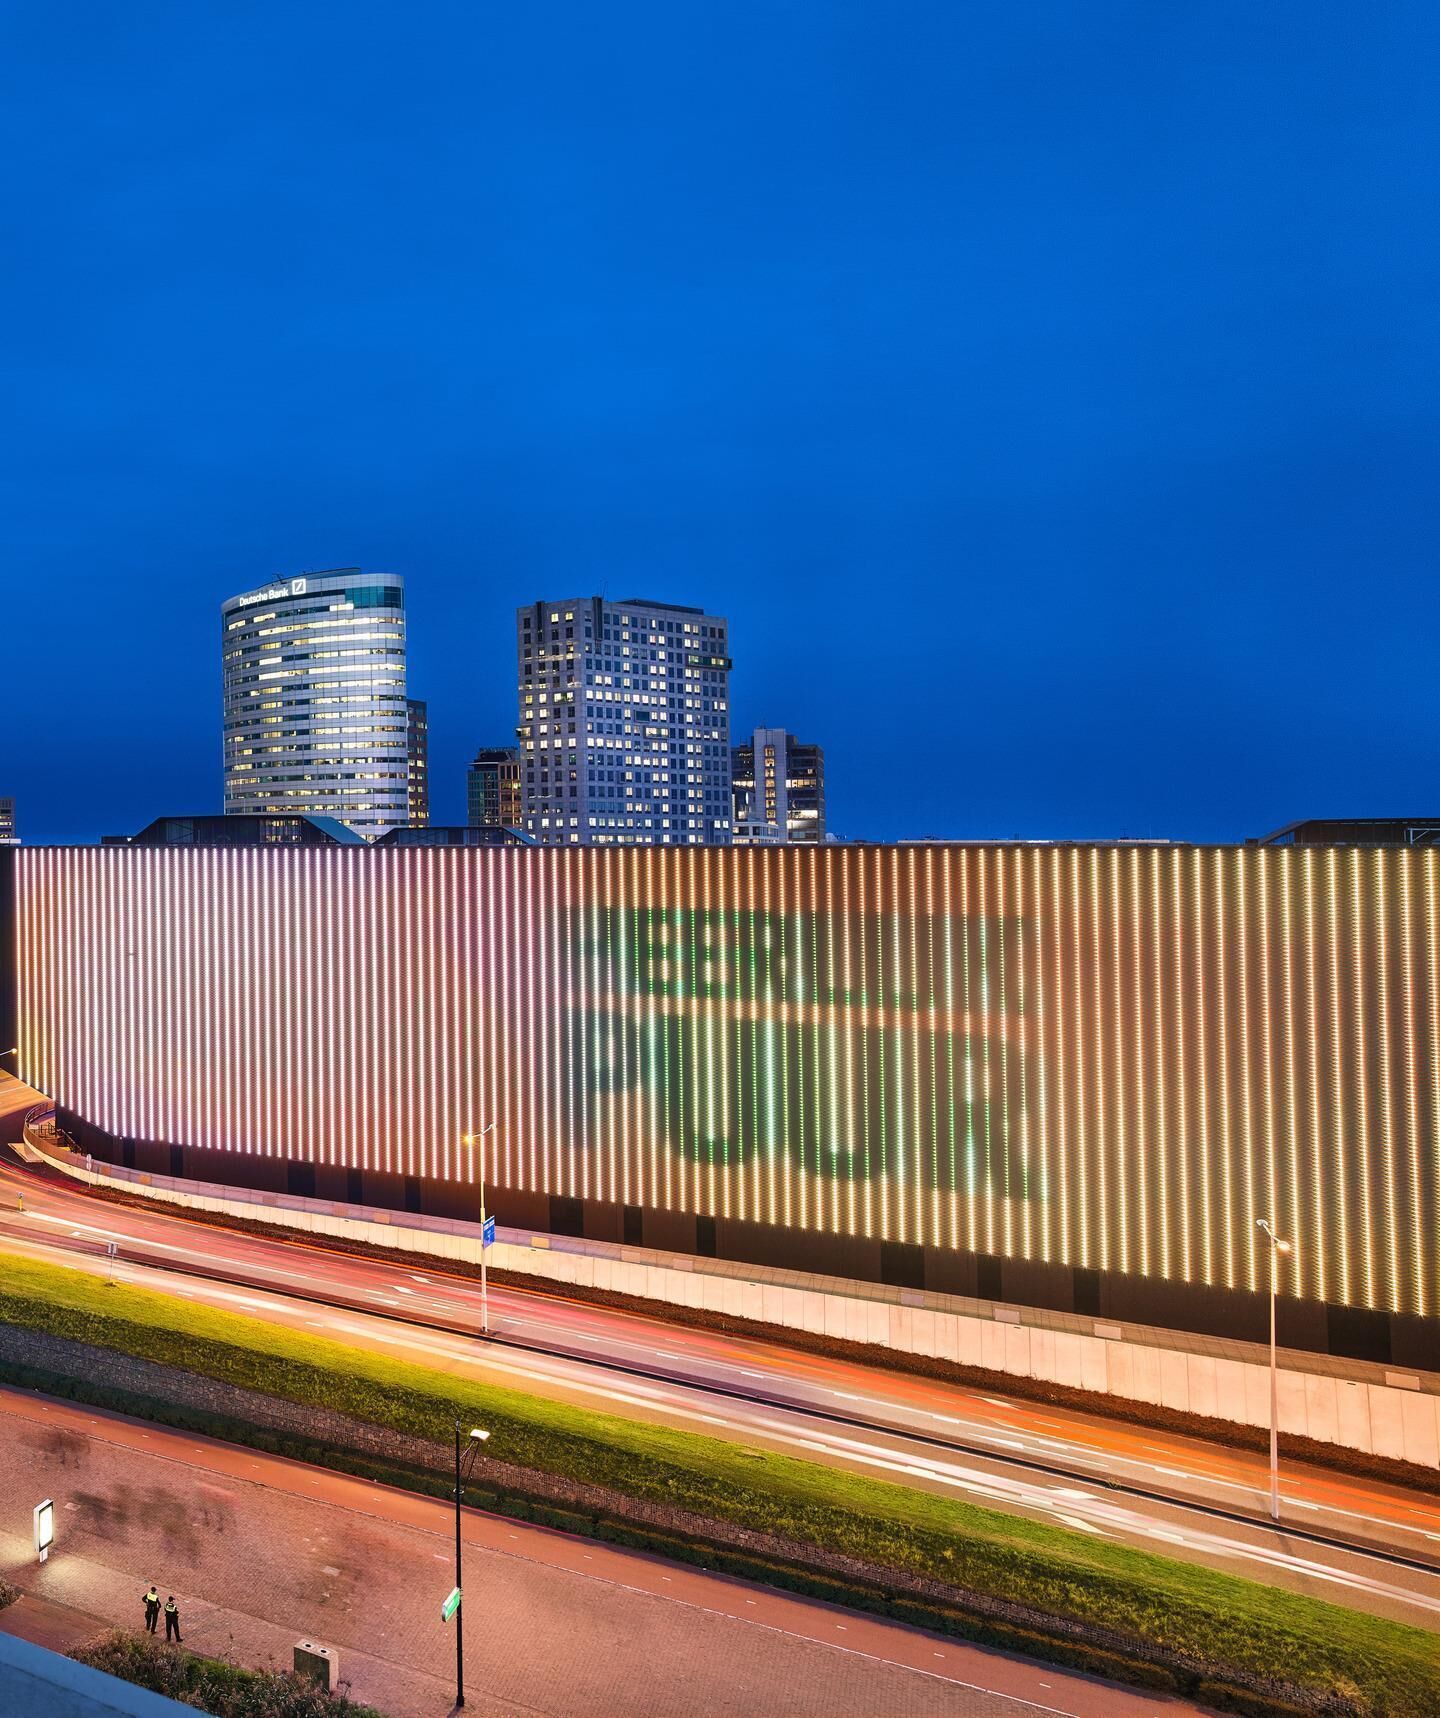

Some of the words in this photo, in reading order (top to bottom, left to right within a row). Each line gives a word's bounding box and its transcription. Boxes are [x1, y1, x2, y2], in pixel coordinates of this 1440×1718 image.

[240, 593, 268, 606] Deutsche
[269, 587, 289, 599] Bank
[563, 1010, 1045, 1204] PUUR
